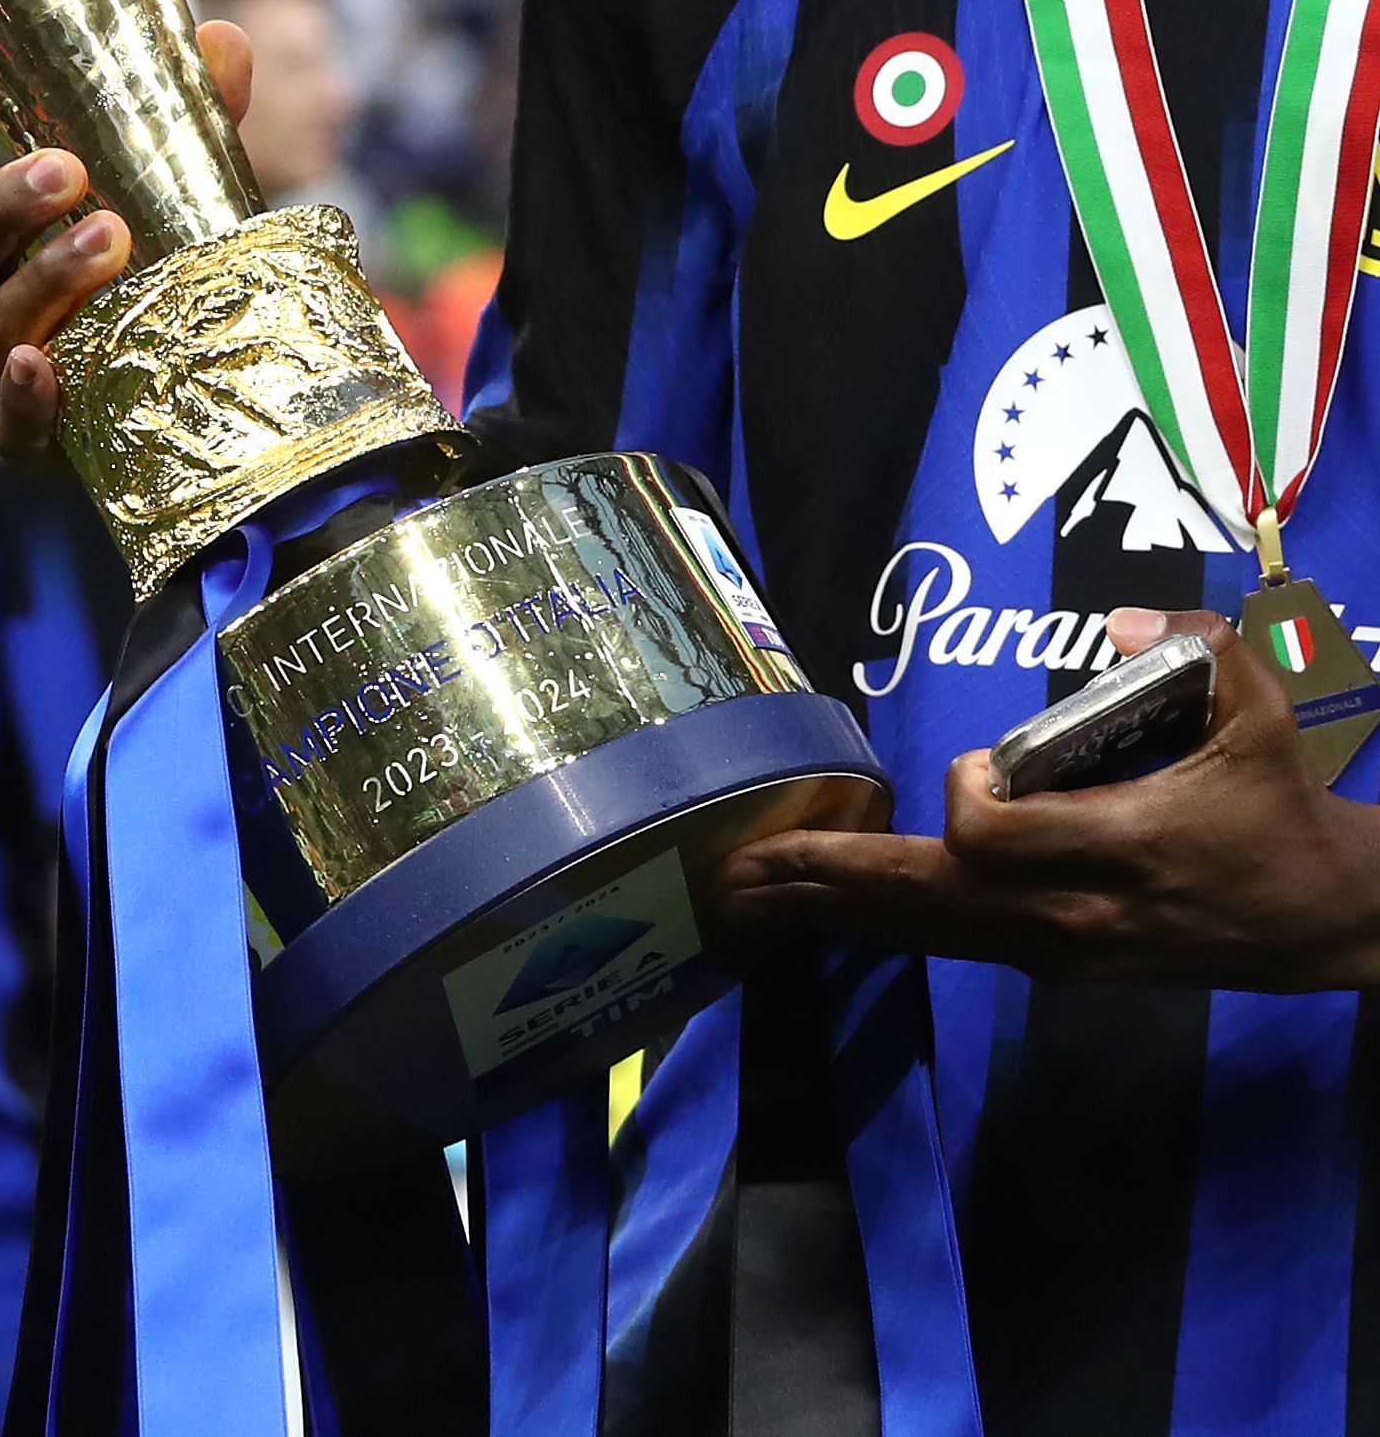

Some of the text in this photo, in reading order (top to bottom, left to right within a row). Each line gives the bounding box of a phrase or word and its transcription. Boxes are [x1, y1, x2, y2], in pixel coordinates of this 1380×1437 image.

[238, 640, 463, 809] AMPIONE
[362, 732, 460, 813] 2023
[504, 668, 591, 727] 024
[497, 950, 668, 1048] SERIE A
[570, 977, 674, 1039] TIM
